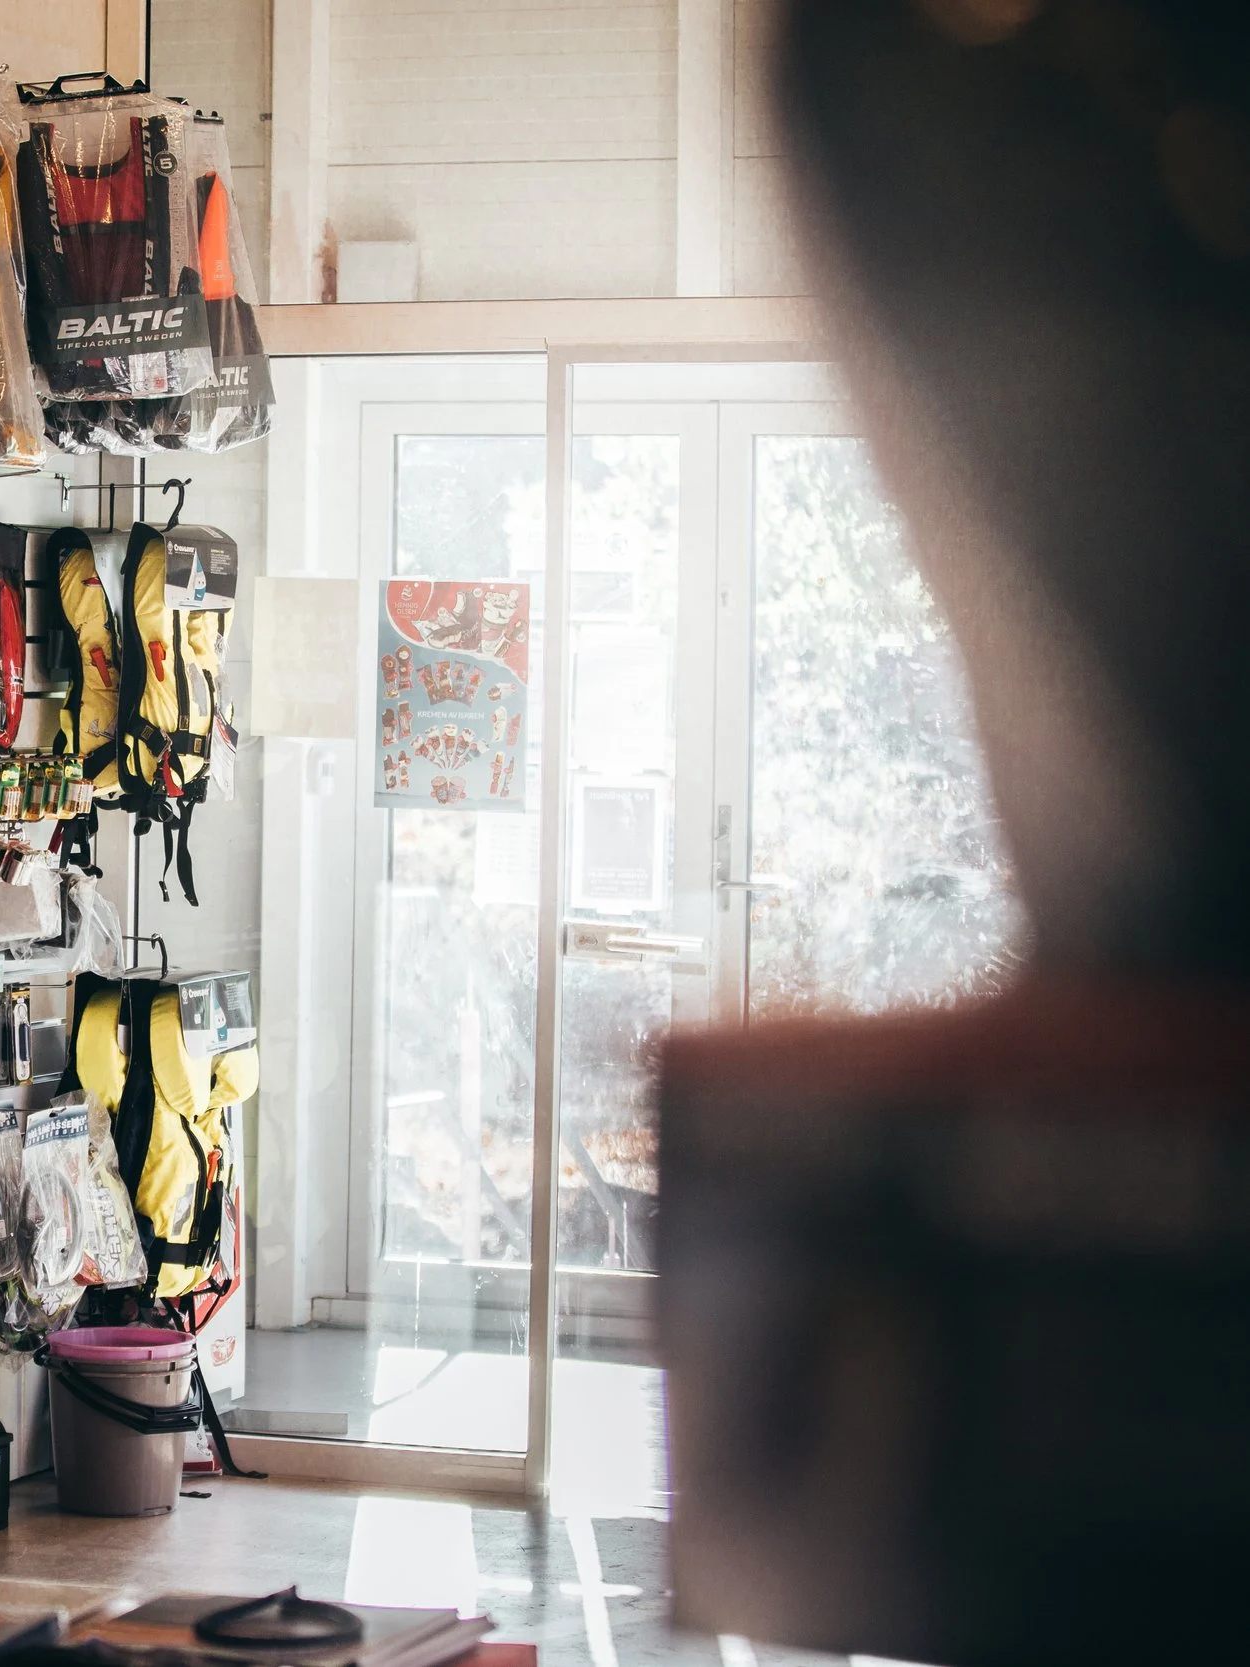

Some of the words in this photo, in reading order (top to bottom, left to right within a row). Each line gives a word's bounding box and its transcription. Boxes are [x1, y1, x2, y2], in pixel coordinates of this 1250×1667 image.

[159, 158, 173, 170] 5
[57, 306, 185, 340] BALTIC
[56, 337, 131, 350] LIFEJACKETS
[136, 330, 183, 344] SWEDEN
[394, 602, 419, 610] HENNIG
[417, 711, 447, 719] KREMEN
